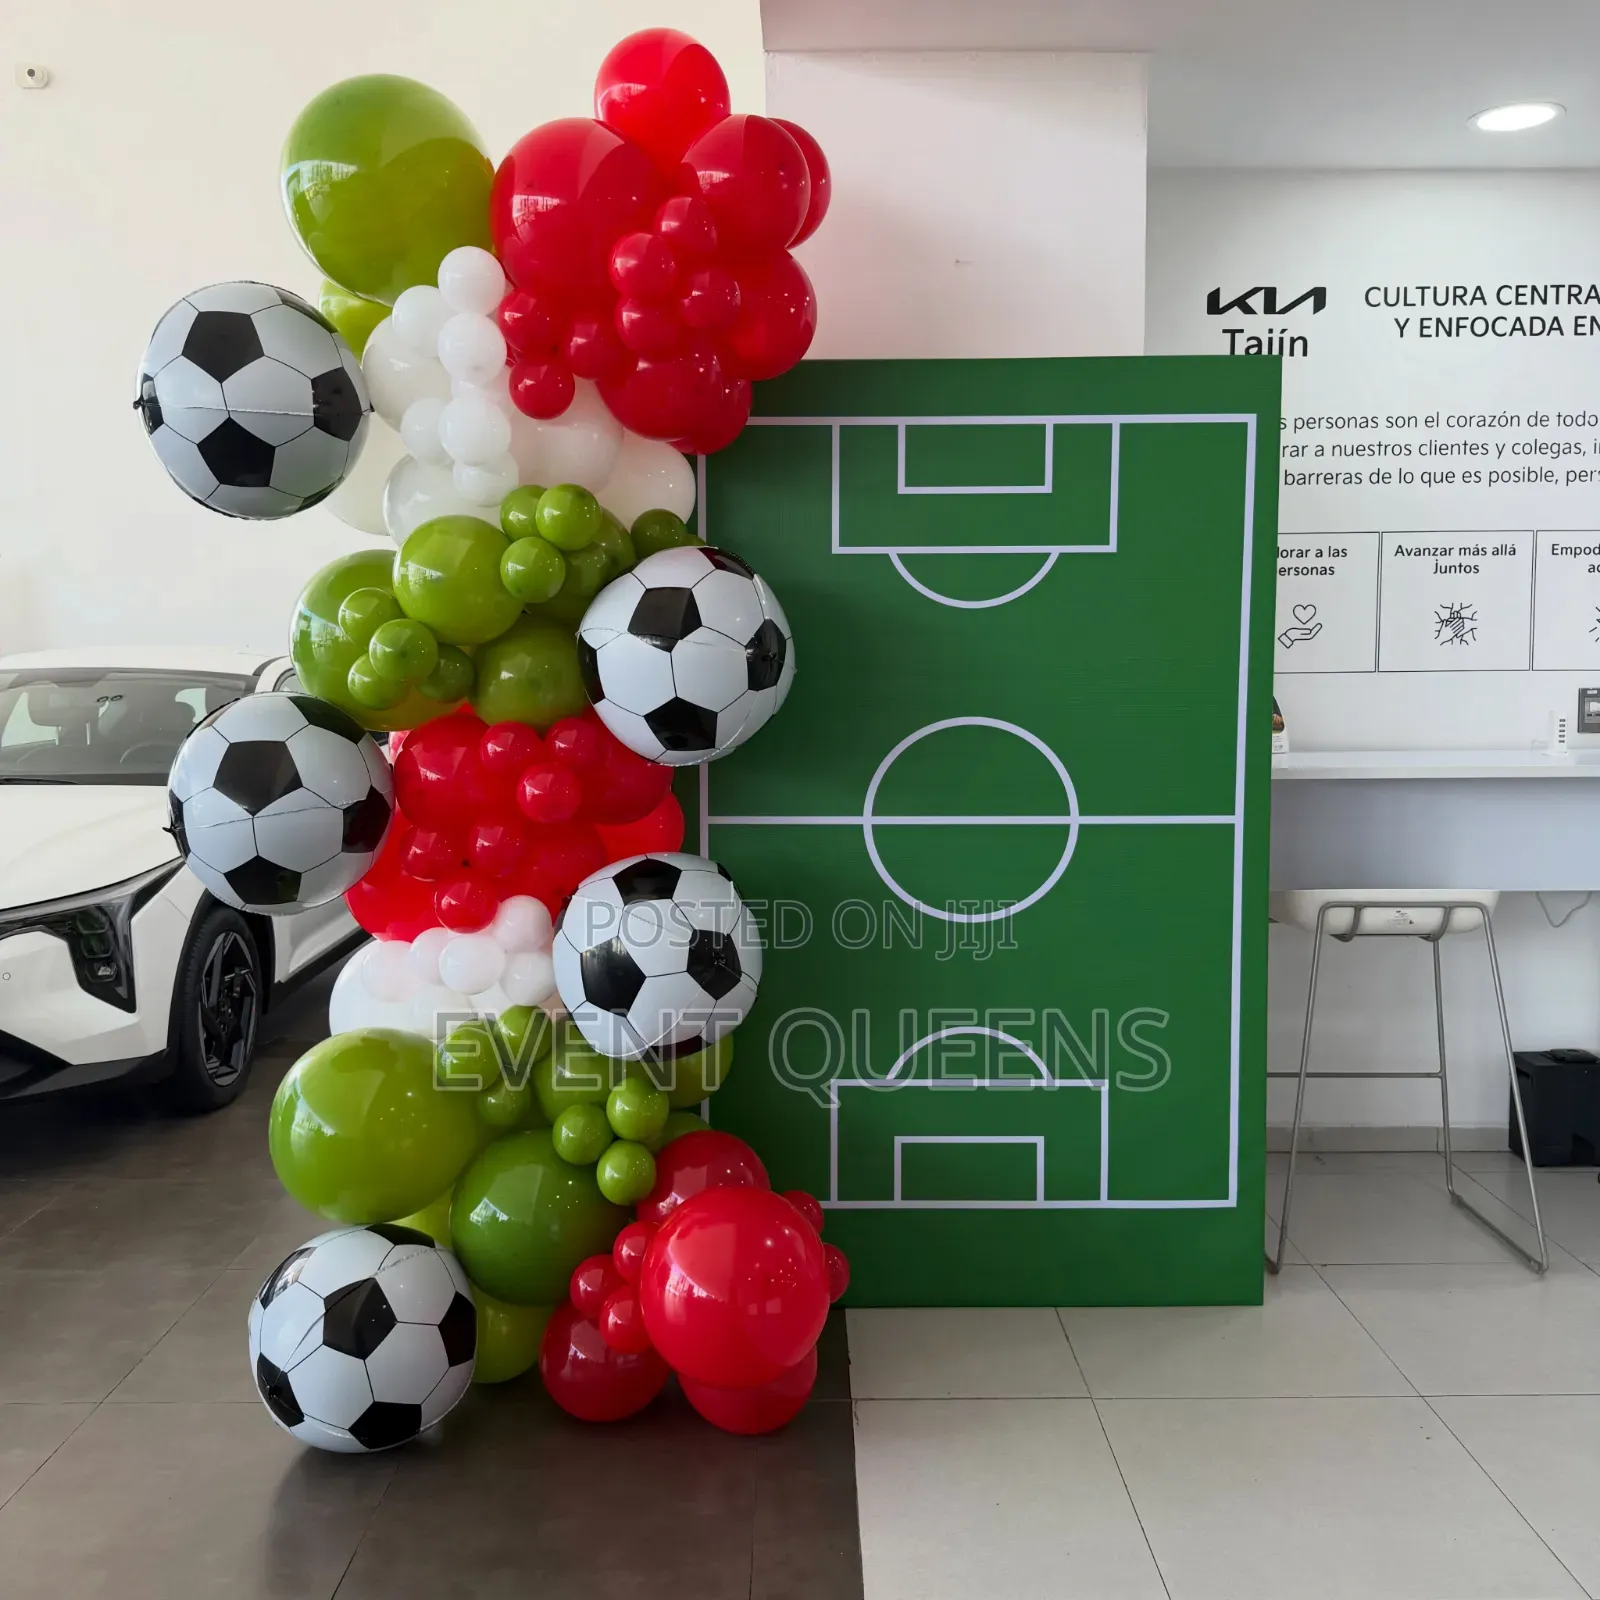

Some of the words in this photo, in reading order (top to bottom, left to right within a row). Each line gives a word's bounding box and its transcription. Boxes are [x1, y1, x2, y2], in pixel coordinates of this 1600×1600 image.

[1364, 285, 1488, 308] CULTURA
[1495, 283, 1600, 306] CENTRA
[1393, 317, 1411, 338] Y
[1419, 315, 1565, 338] ENFOCADA
[1293, 415, 1379, 434] personas
[1385, 415, 1418, 429] son
[1424, 411, 1440, 428] el
[1446, 410, 1521, 428] corazón
[1526, 410, 1550, 428] de
[1555, 410, 1599, 428] todo
[1314, 444, 1325, 457] a
[1331, 440, 1413, 457] nuestros
[1418, 439, 1490, 456] clientes
[1495, 442, 1506, 460] y
[1511, 438, 1587, 460] colegas,
[1283, 468, 1363, 486] barreras
[1368, 467, 1393, 484] de
[1398, 467, 1415, 484] lo
[1420, 470, 1456, 488] que
[1461, 470, 1482, 484] es
[1488, 465, 1560, 488] posible,
[1314, 548, 1324, 559] a
[1327, 545, 1348, 558] las
[1393, 544, 1455, 557] Avanzar
[1458, 543, 1488, 557] más
[1491, 543, 1517, 556] allá
[1278, 565, 1336, 577] ersonas
